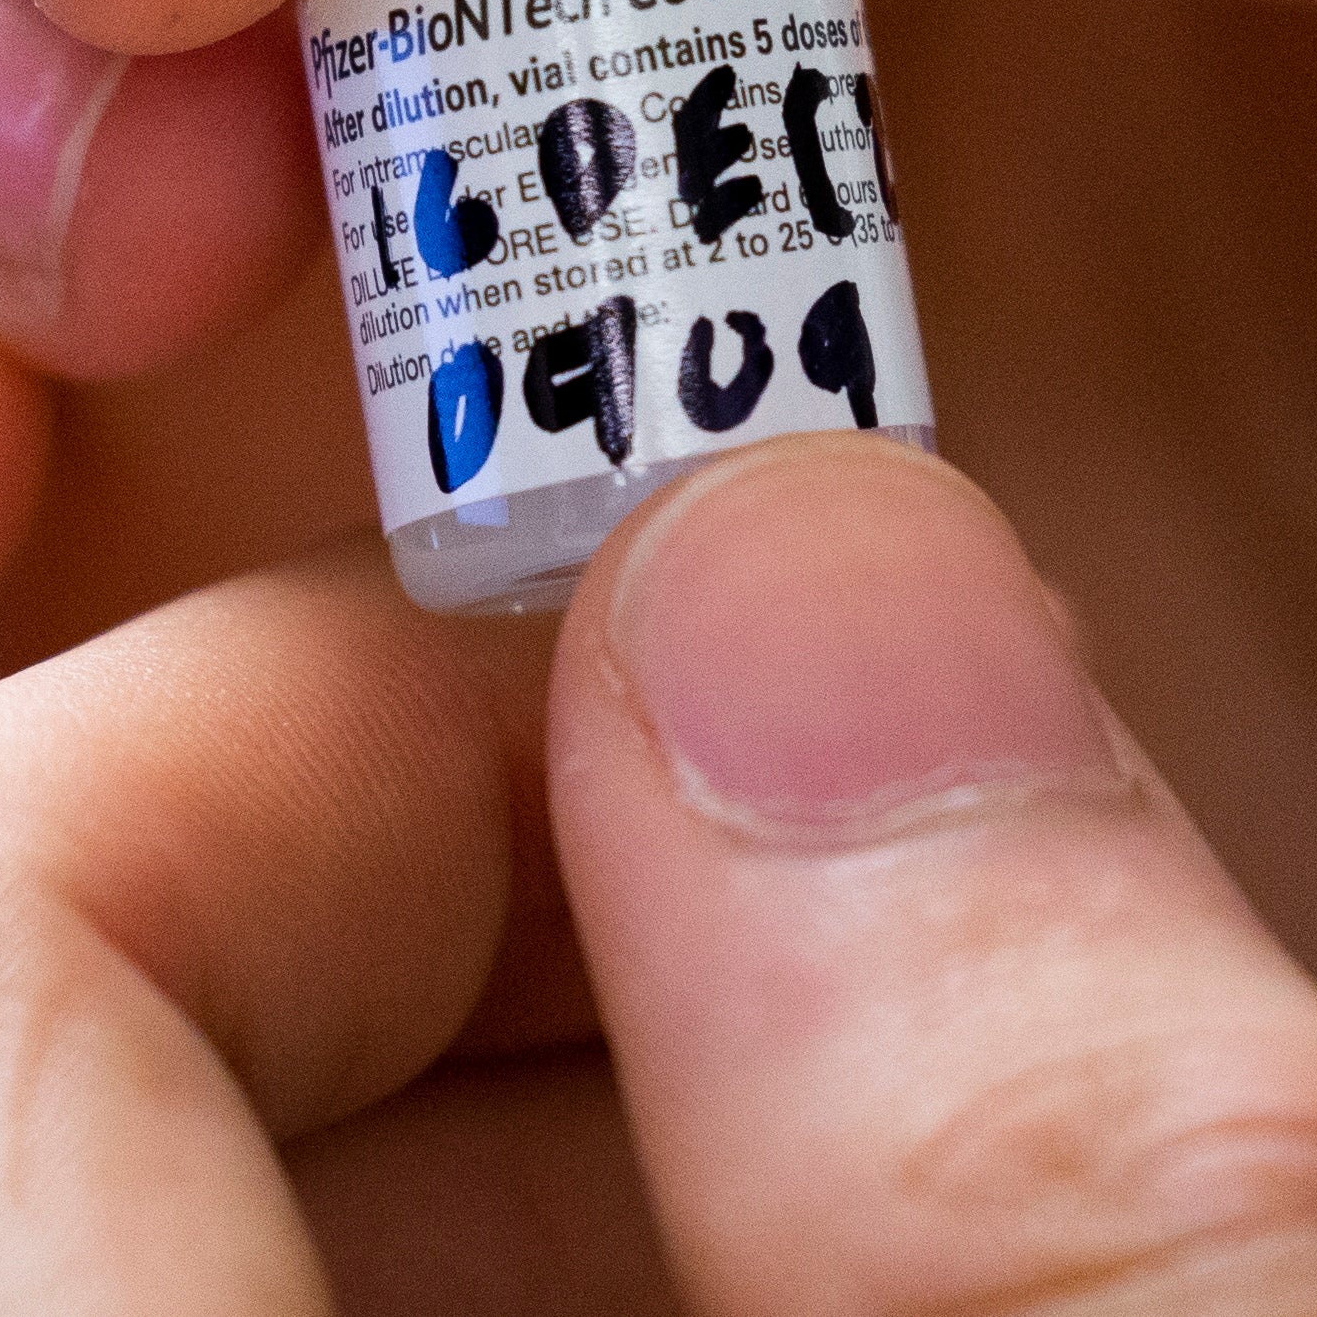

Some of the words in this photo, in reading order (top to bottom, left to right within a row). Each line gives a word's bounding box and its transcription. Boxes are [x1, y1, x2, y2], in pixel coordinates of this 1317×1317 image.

[322, 107, 365, 151] After
[371, 78, 500, 134] dilution,
[508, 49, 578, 97] vial
[588, 25, 747, 82] contains
[752, 17, 774, 56] 5
[781, 12, 849, 53] doses
[332, 168, 355, 203] For
[357, 121, 546, 192] intramscular
[639, 75, 782, 123] Coains
[342, 220, 366, 254] For
[359, 301, 431, 346] dilution
[434, 278, 523, 320] when
[534, 247, 648, 297] stored
[662, 240, 696, 271] at
[735, 231, 769, 259] to
[778, 219, 814, 253] 25
[365, 352, 433, 395] Dilution
